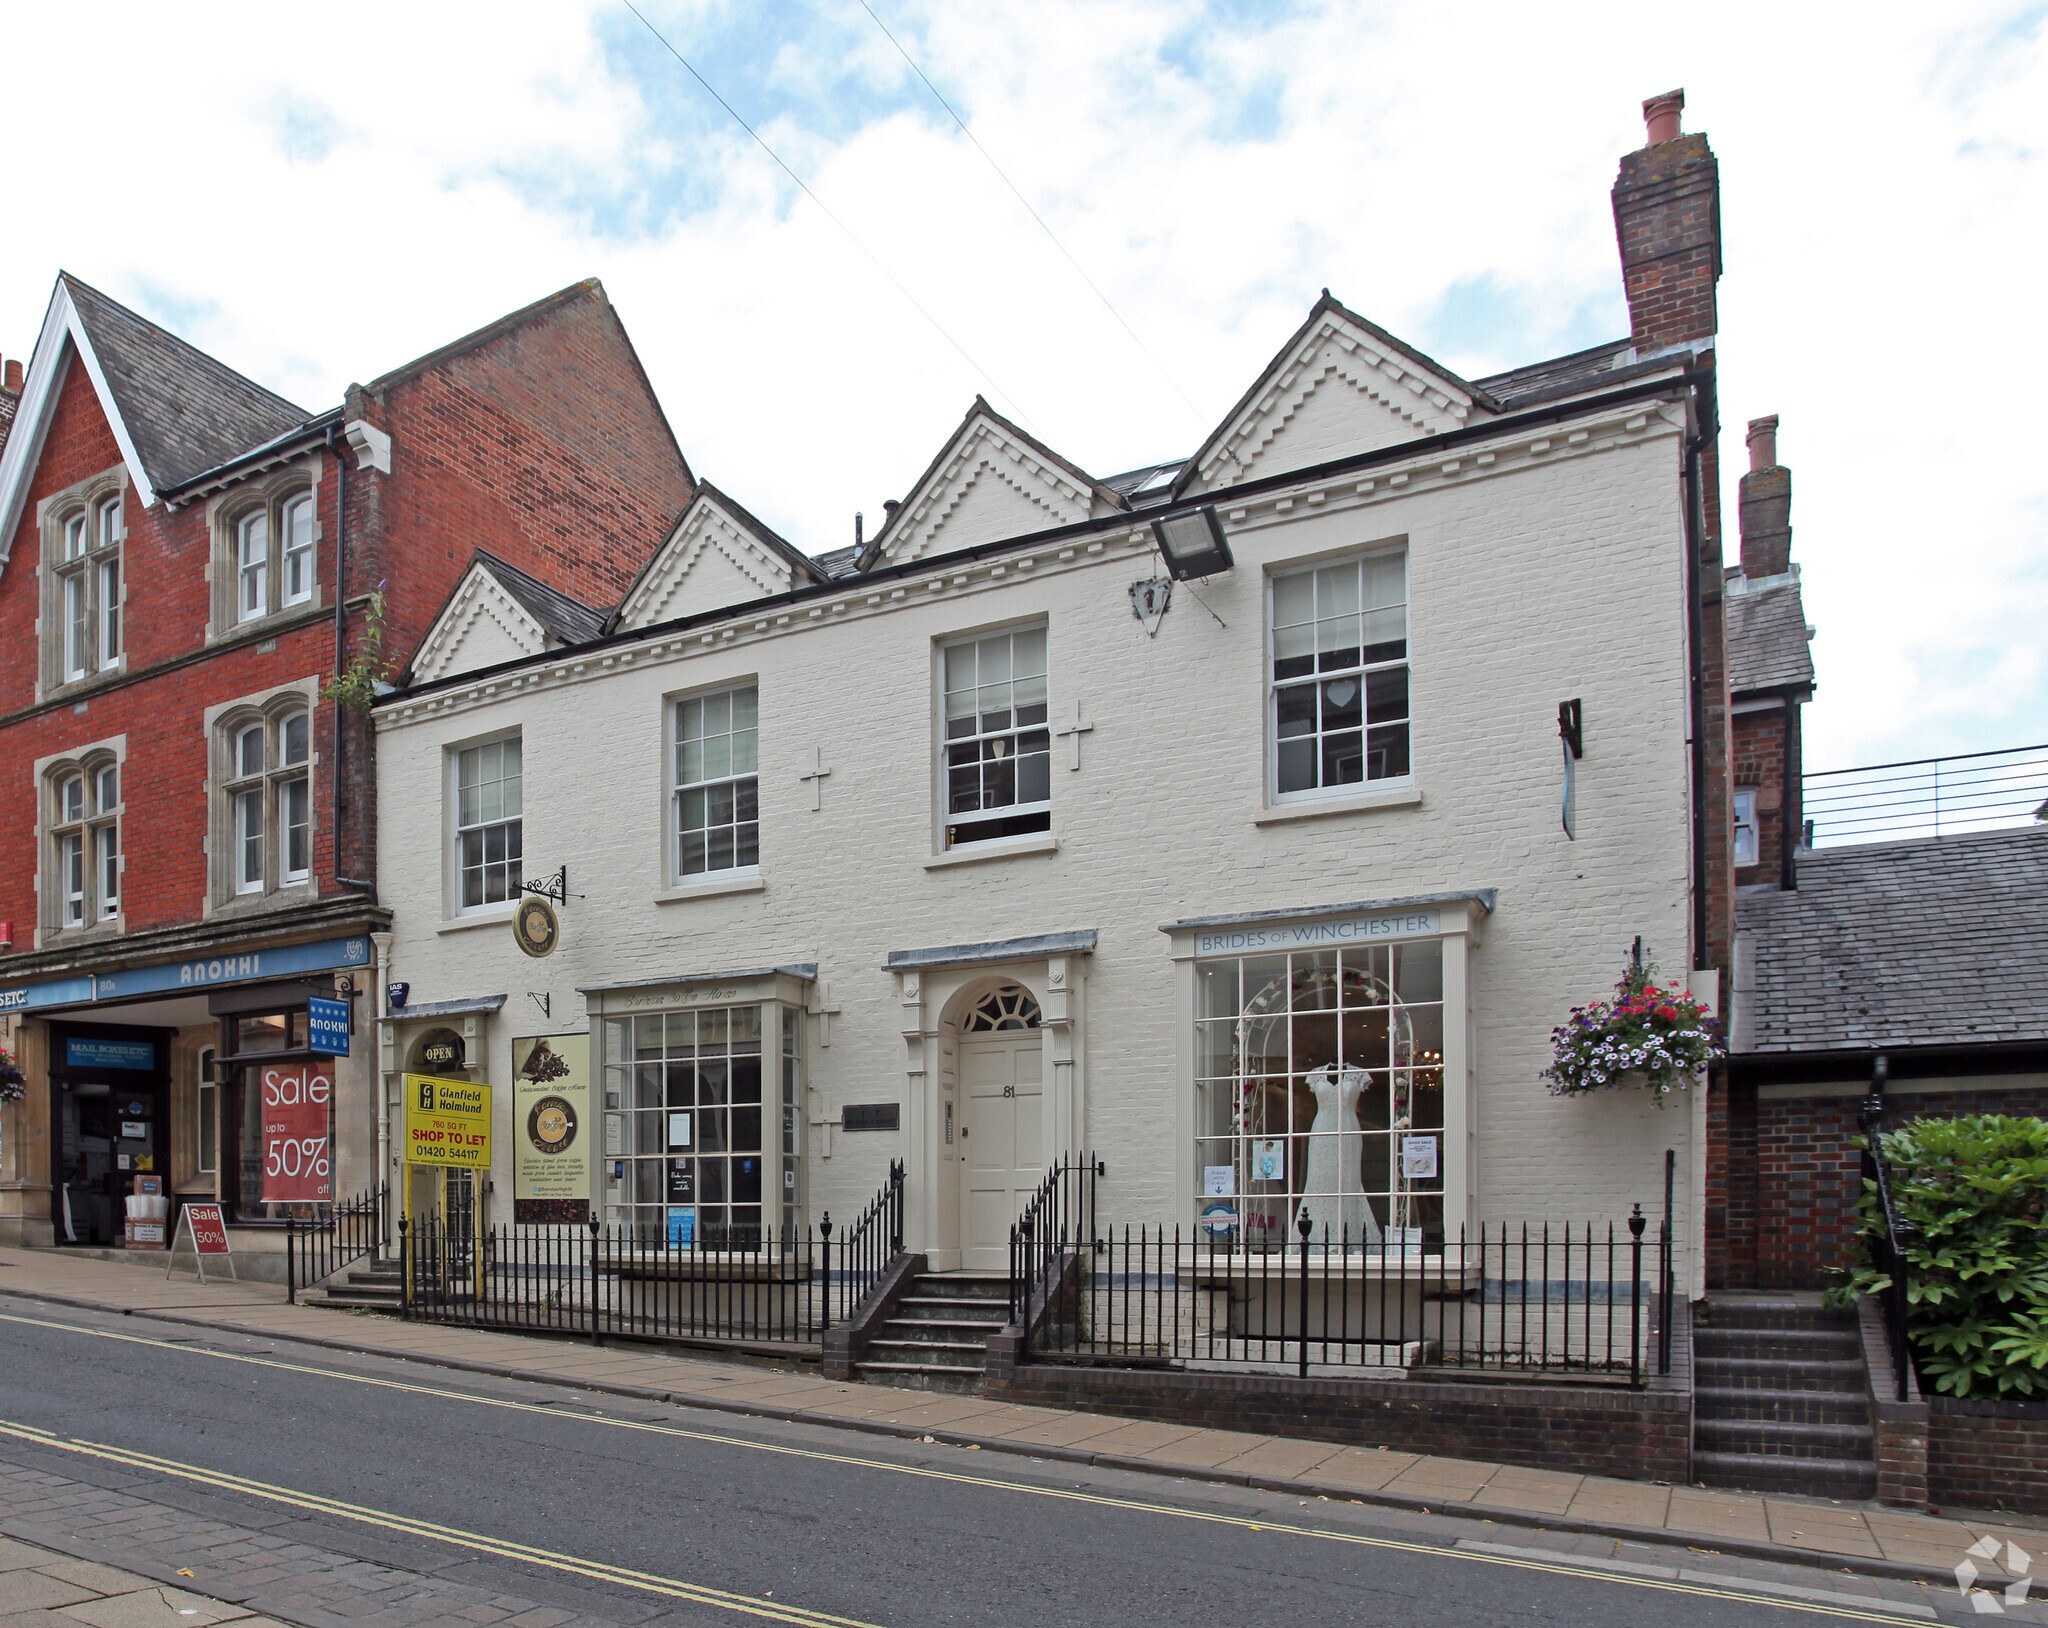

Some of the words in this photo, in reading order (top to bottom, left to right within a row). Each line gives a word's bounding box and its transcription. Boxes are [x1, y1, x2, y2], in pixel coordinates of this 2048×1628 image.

[1202, 931, 1266, 951] BRIDES
[1270, 932, 1287, 943] OF
[1292, 915, 1431, 942] WINCHESTER
[180, 955, 260, 983] ANOKHI
[310, 1017, 348, 1034] ANOKHI
[71, 1043, 97, 1053] MAIL
[426, 1047, 453, 1060] OPEN
[265, 1068, 330, 1106] Sale
[423, 1085, 431, 1096] G
[1003, 1085, 1015, 1098] 81
[440, 1087, 481, 1101] Glanfield
[423, 1097, 431, 1108] H
[440, 1100, 482, 1113] Holmlund
[265, 1126, 276, 1135] up
[277, 1124, 285, 1133] to
[447, 1122, 457, 1130] SQ
[459, 1123, 467, 1131] FT
[412, 1128, 444, 1142] SHOP
[448, 1132, 463, 1144] TO
[466, 1134, 486, 1146] LET
[266, 1137, 329, 1178] 50%
[416, 1145, 446, 1158] 01420
[449, 1148, 479, 1160] 544117
[318, 1184, 330, 1194] off
[191, 1208, 219, 1220] Sale
[196, 1232, 224, 1243] 50%
